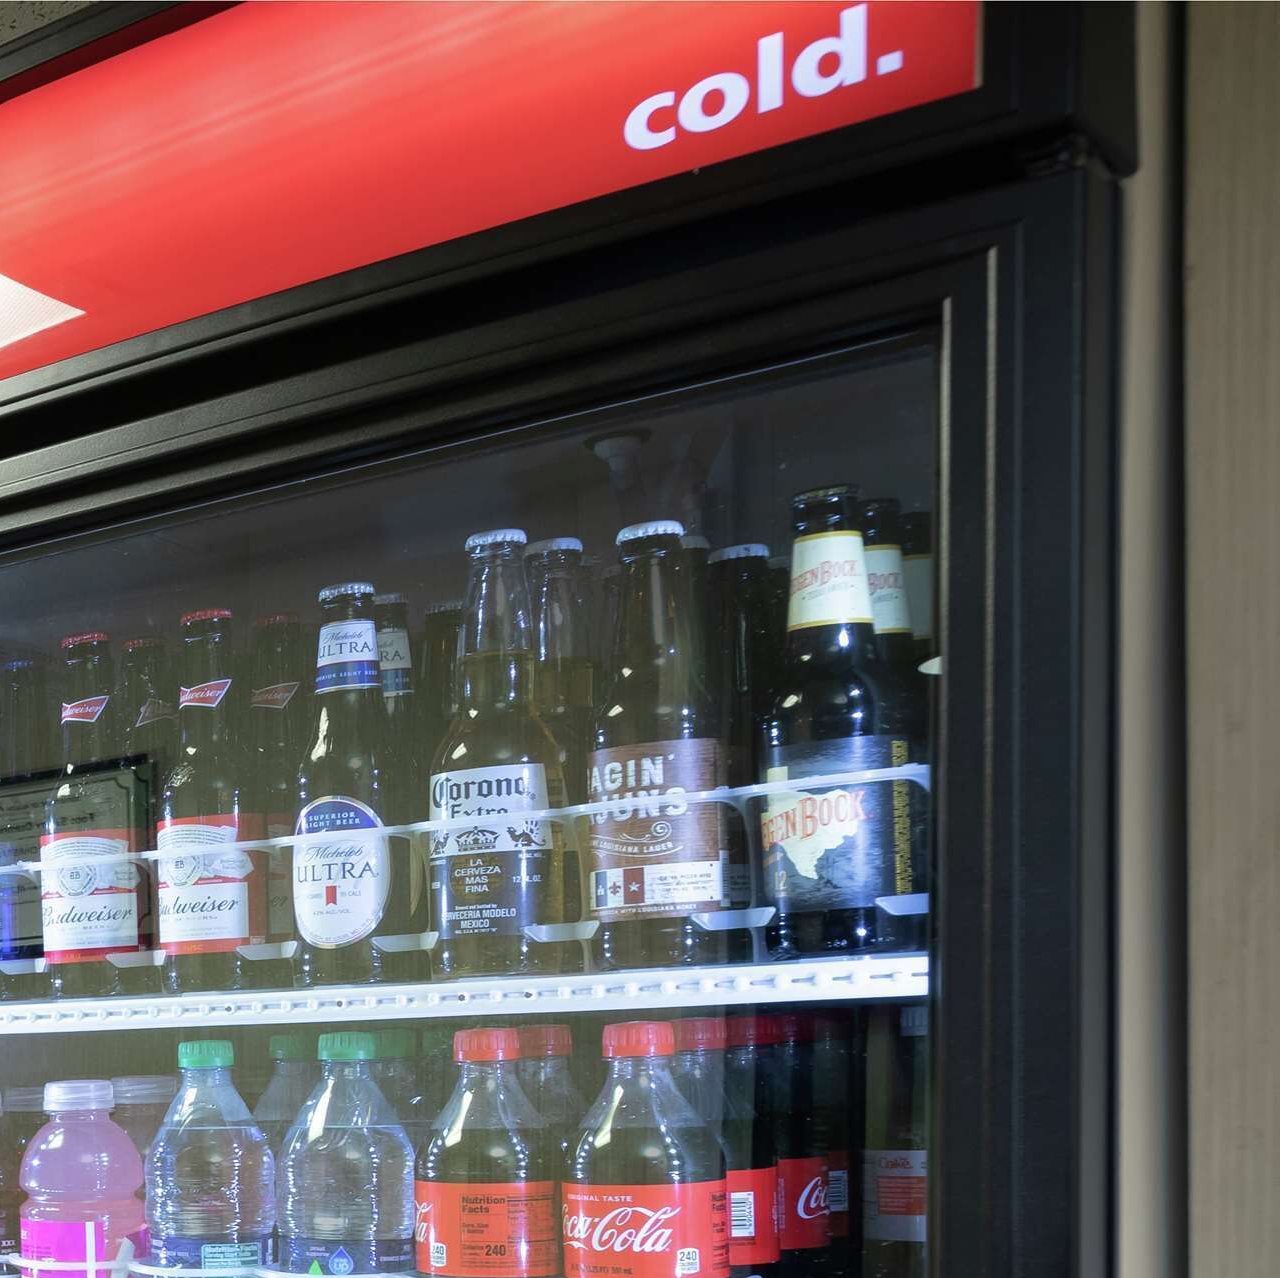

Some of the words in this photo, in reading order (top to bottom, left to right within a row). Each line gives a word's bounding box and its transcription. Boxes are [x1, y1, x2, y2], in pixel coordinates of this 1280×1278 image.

[623, 2, 903, 150] cold.
[320, 641, 373, 659] ULTRA
[309, 811, 356, 821] SUPERIOR
[337, 817, 360, 826] BEER
[469, 858, 483, 866] LA
[297, 862, 377, 883] ULTRA
[454, 866, 502, 877] CERVEZA
[465, 875, 488, 884] MAS
[465, 884, 489, 893] FINA
[482, 908, 516, 918] MODELO
[460, 919, 490, 929] MEXICO
[461, 1196, 506, 1205] Nutrition
[461, 1205, 489, 1214] Facts
[485, 1244, 506, 1256] 240
[679, 1250, 697, 1262] 240
